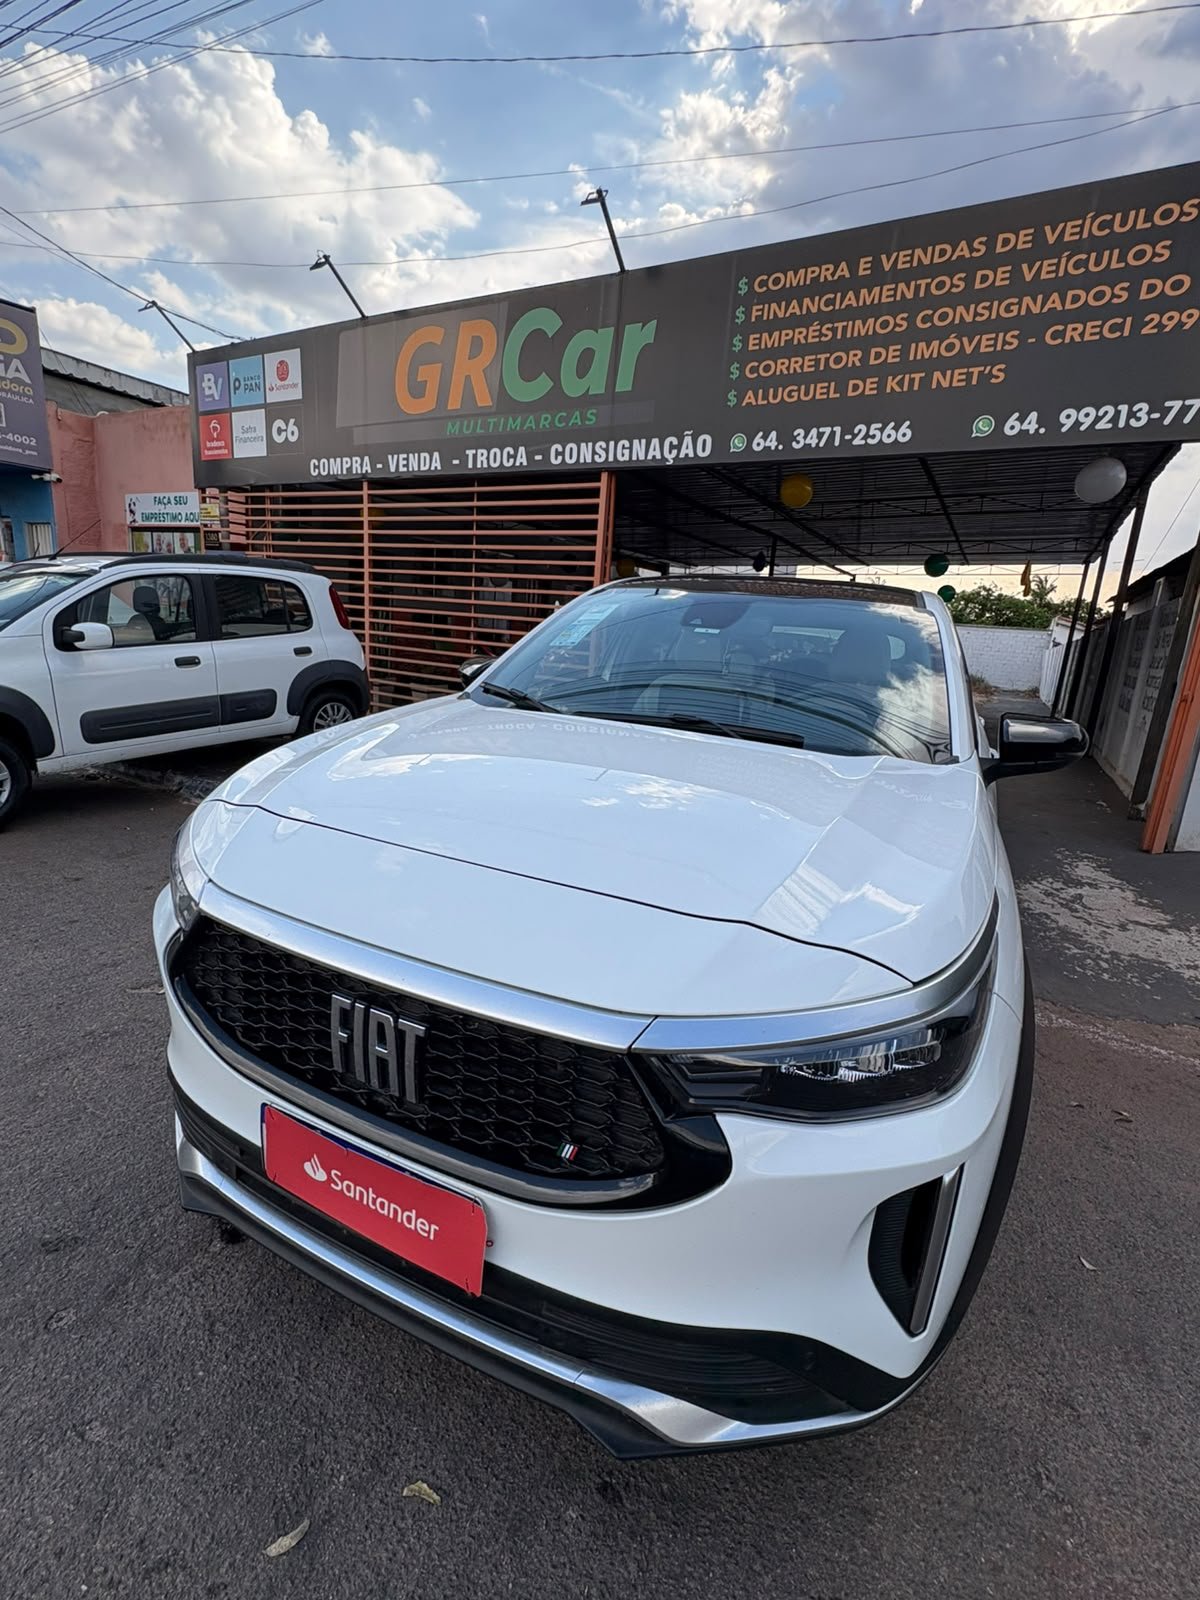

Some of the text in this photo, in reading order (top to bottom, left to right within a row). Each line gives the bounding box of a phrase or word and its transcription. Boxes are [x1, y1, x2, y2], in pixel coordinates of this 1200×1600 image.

[753, 261, 850, 293] COMPRA
[858, 256, 872, 276] E
[880, 236, 987, 272] VENDAS
[995, 229, 1034, 254] DE
[1044, 198, 1200, 245] VEÍCULOS
[751, 272, 966, 322] FINANCIAMENTOS
[974, 266, 1011, 289] DE
[1021, 239, 1173, 282] VEÍCULOS
[748, 313, 908, 351] EMPRÉSTIMOS
[915, 281, 1130, 330] CONSIGNADOS
[1139, 273, 1192, 300] DO
[744, 350, 863, 379] CORRETOR
[869, 345, 901, 366] DE
[908, 329, 1019, 361] IMÓVEIS
[1045, 316, 1133, 346] CRECI
[1140, 308, 1200, 335] 299
[0, 379, 33, 396] dora
[243, 382, 261, 393] PAN
[274, 382, 299, 392] Santander
[742, 382, 840, 406] ALUGUEL
[847, 378, 878, 397] DE
[885, 369, 925, 393] KIT
[241, 425, 257, 435] Safra
[272, 418, 299, 443] C6
[446, 409, 598, 435] MULTIMARCAS
[1003, 411, 1047, 437] 64.
[234, 435, 264, 444] Financeira
[751, 421, 912, 452] 64. 3471-2566
[309, 455, 372, 477] COMPRA
[388, 451, 442, 473] VENDA
[465, 446, 528, 470] TROCA
[550, 430, 712, 465] CONSIGNAÇÃO
[153, 495, 188, 509] FAÇA SEU
[141, 508, 183, 523] EMPRÉSTIMO
[330, 993, 429, 1104] FIAT
[330, 1168, 439, 1241] Santander
